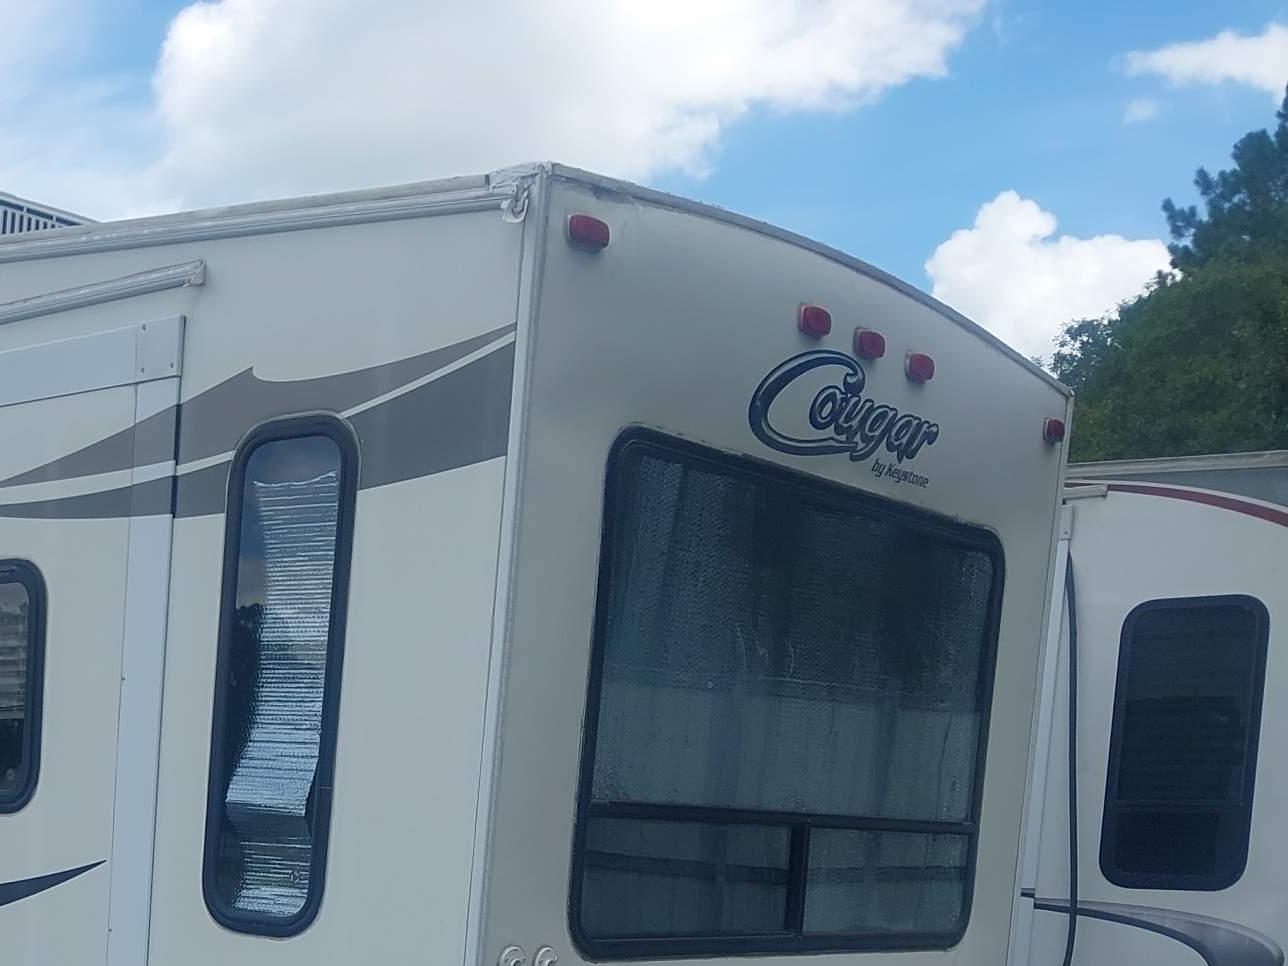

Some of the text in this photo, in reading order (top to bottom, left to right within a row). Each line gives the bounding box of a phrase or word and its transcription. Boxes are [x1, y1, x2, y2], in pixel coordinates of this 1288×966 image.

[748, 349, 940, 464] Cougar
[871, 458, 930, 488] by Keystone
